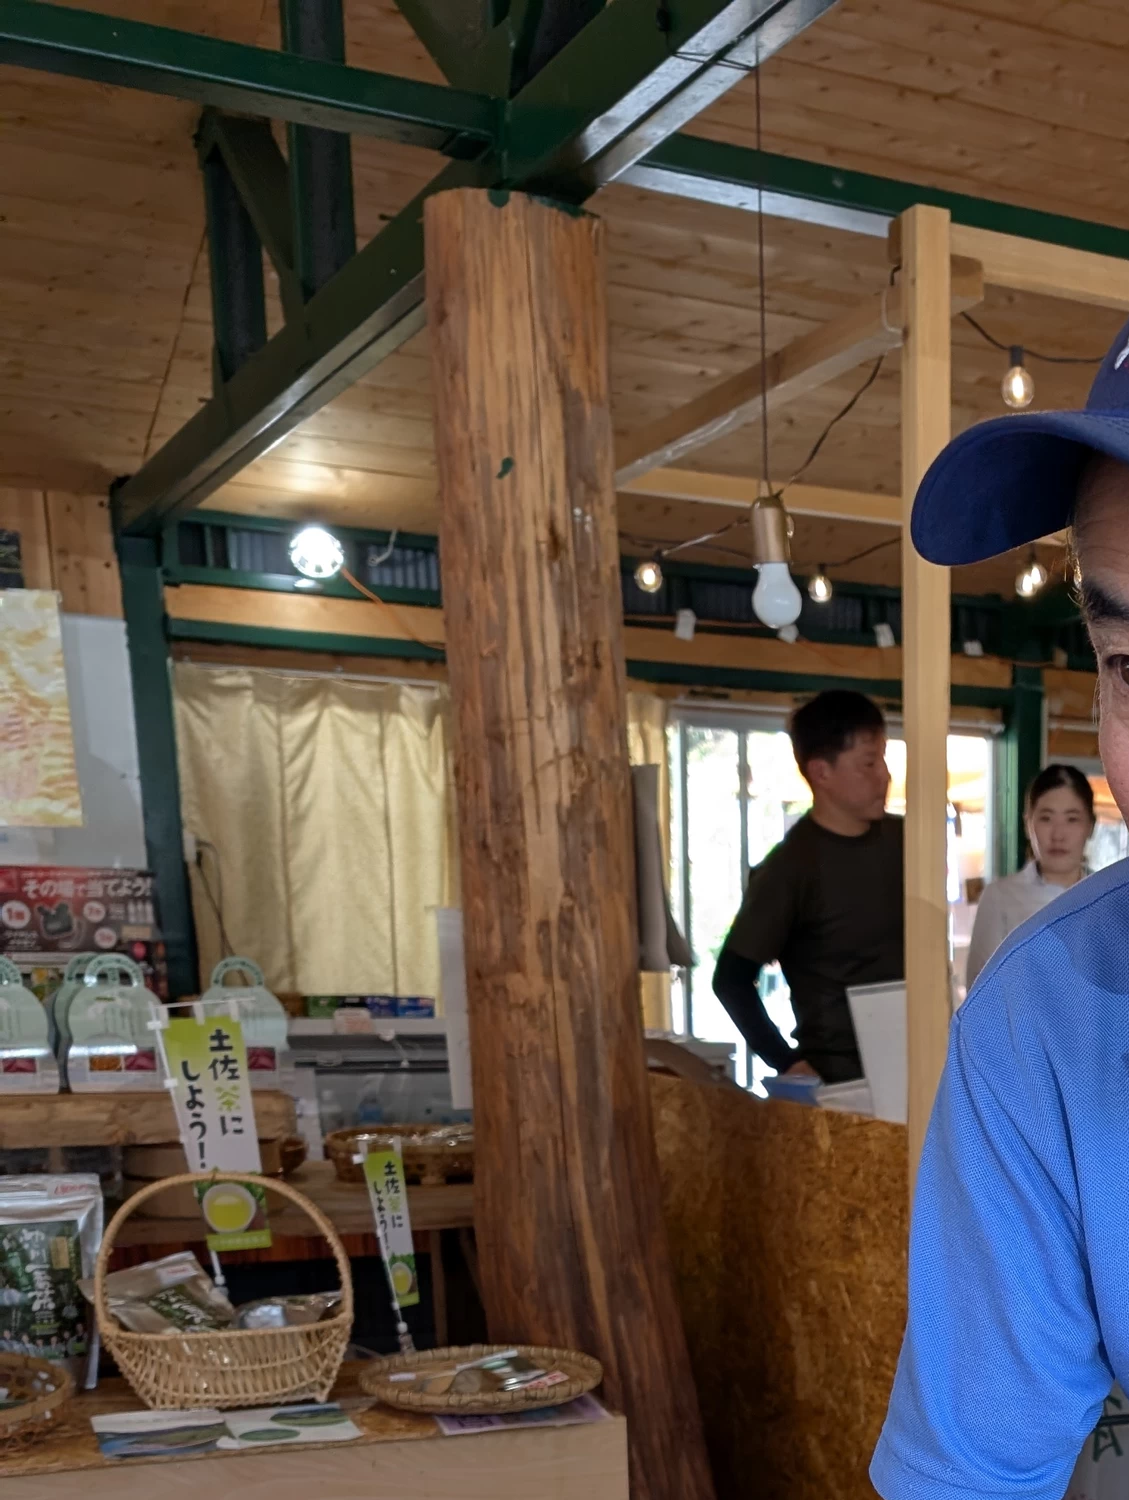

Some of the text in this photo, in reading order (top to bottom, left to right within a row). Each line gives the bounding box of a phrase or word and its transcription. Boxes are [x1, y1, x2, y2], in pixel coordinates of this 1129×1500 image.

[181, 1060, 207, 1169] しよう!
[208, 1028, 244, 1136] 土佐茶に
